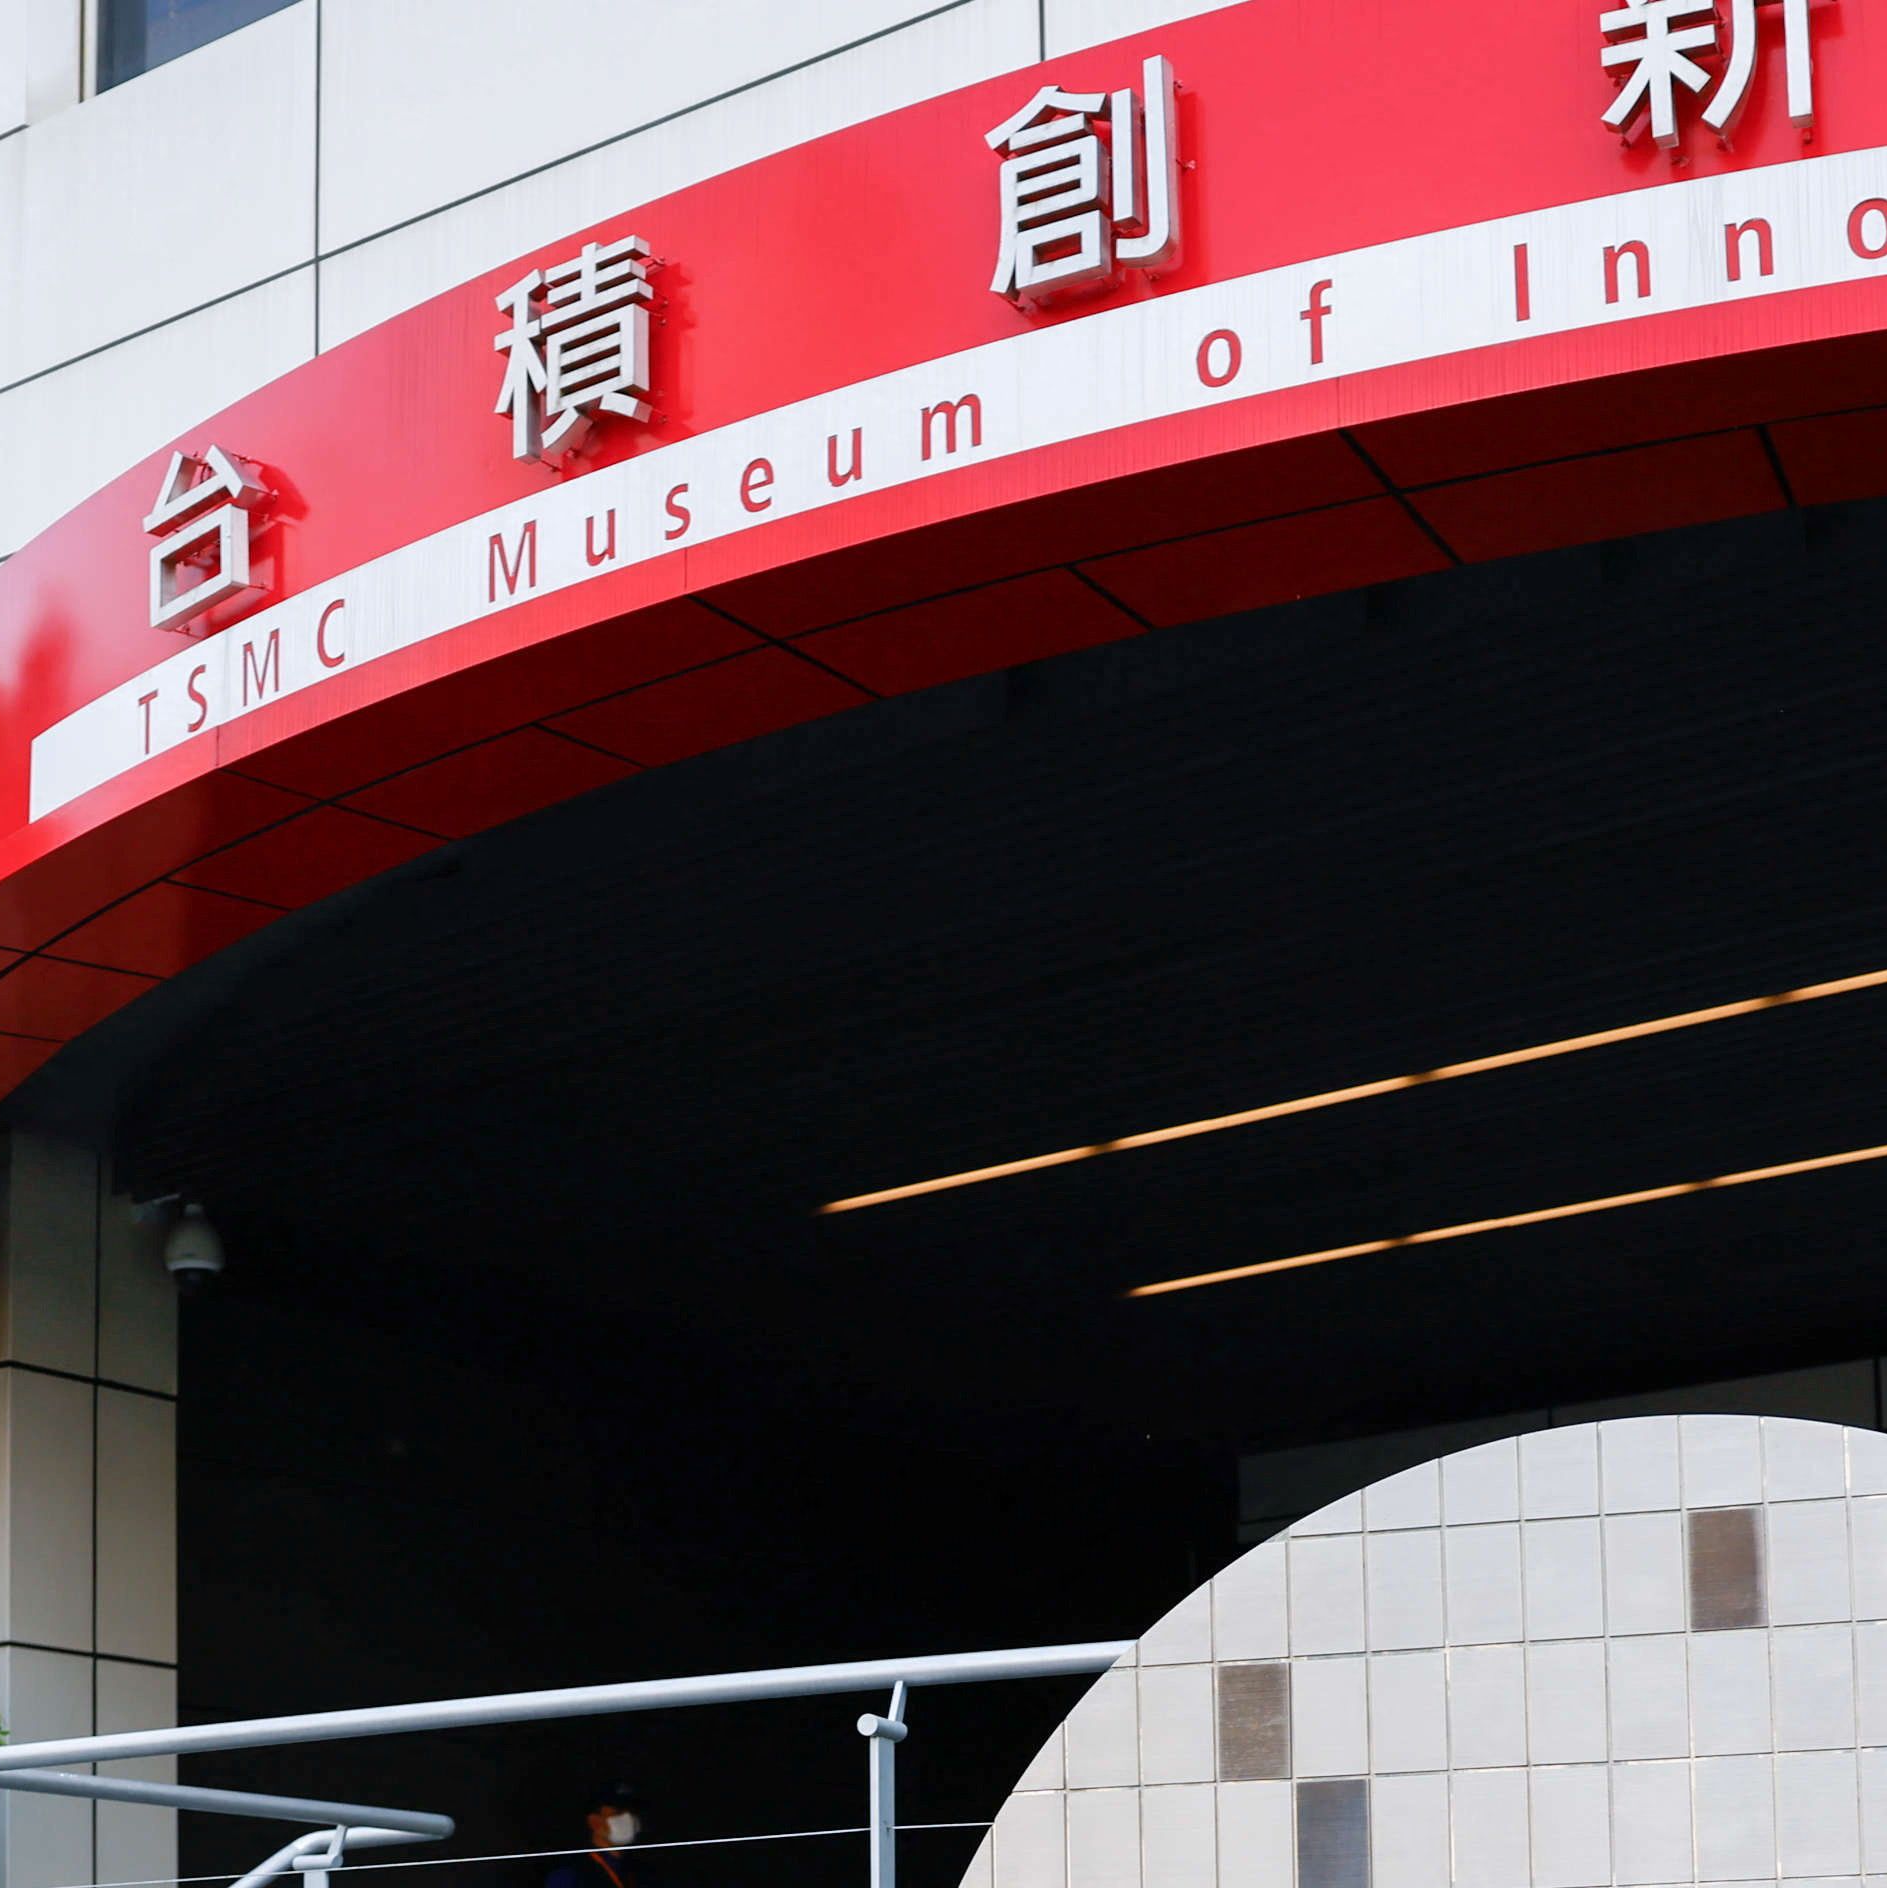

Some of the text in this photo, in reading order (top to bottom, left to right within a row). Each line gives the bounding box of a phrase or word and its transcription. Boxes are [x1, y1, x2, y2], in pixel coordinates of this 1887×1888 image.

[137, 598, 346, 755] TSMC
[488, 393, 982, 603] Museum
[1195, 278, 1333, 388] of
